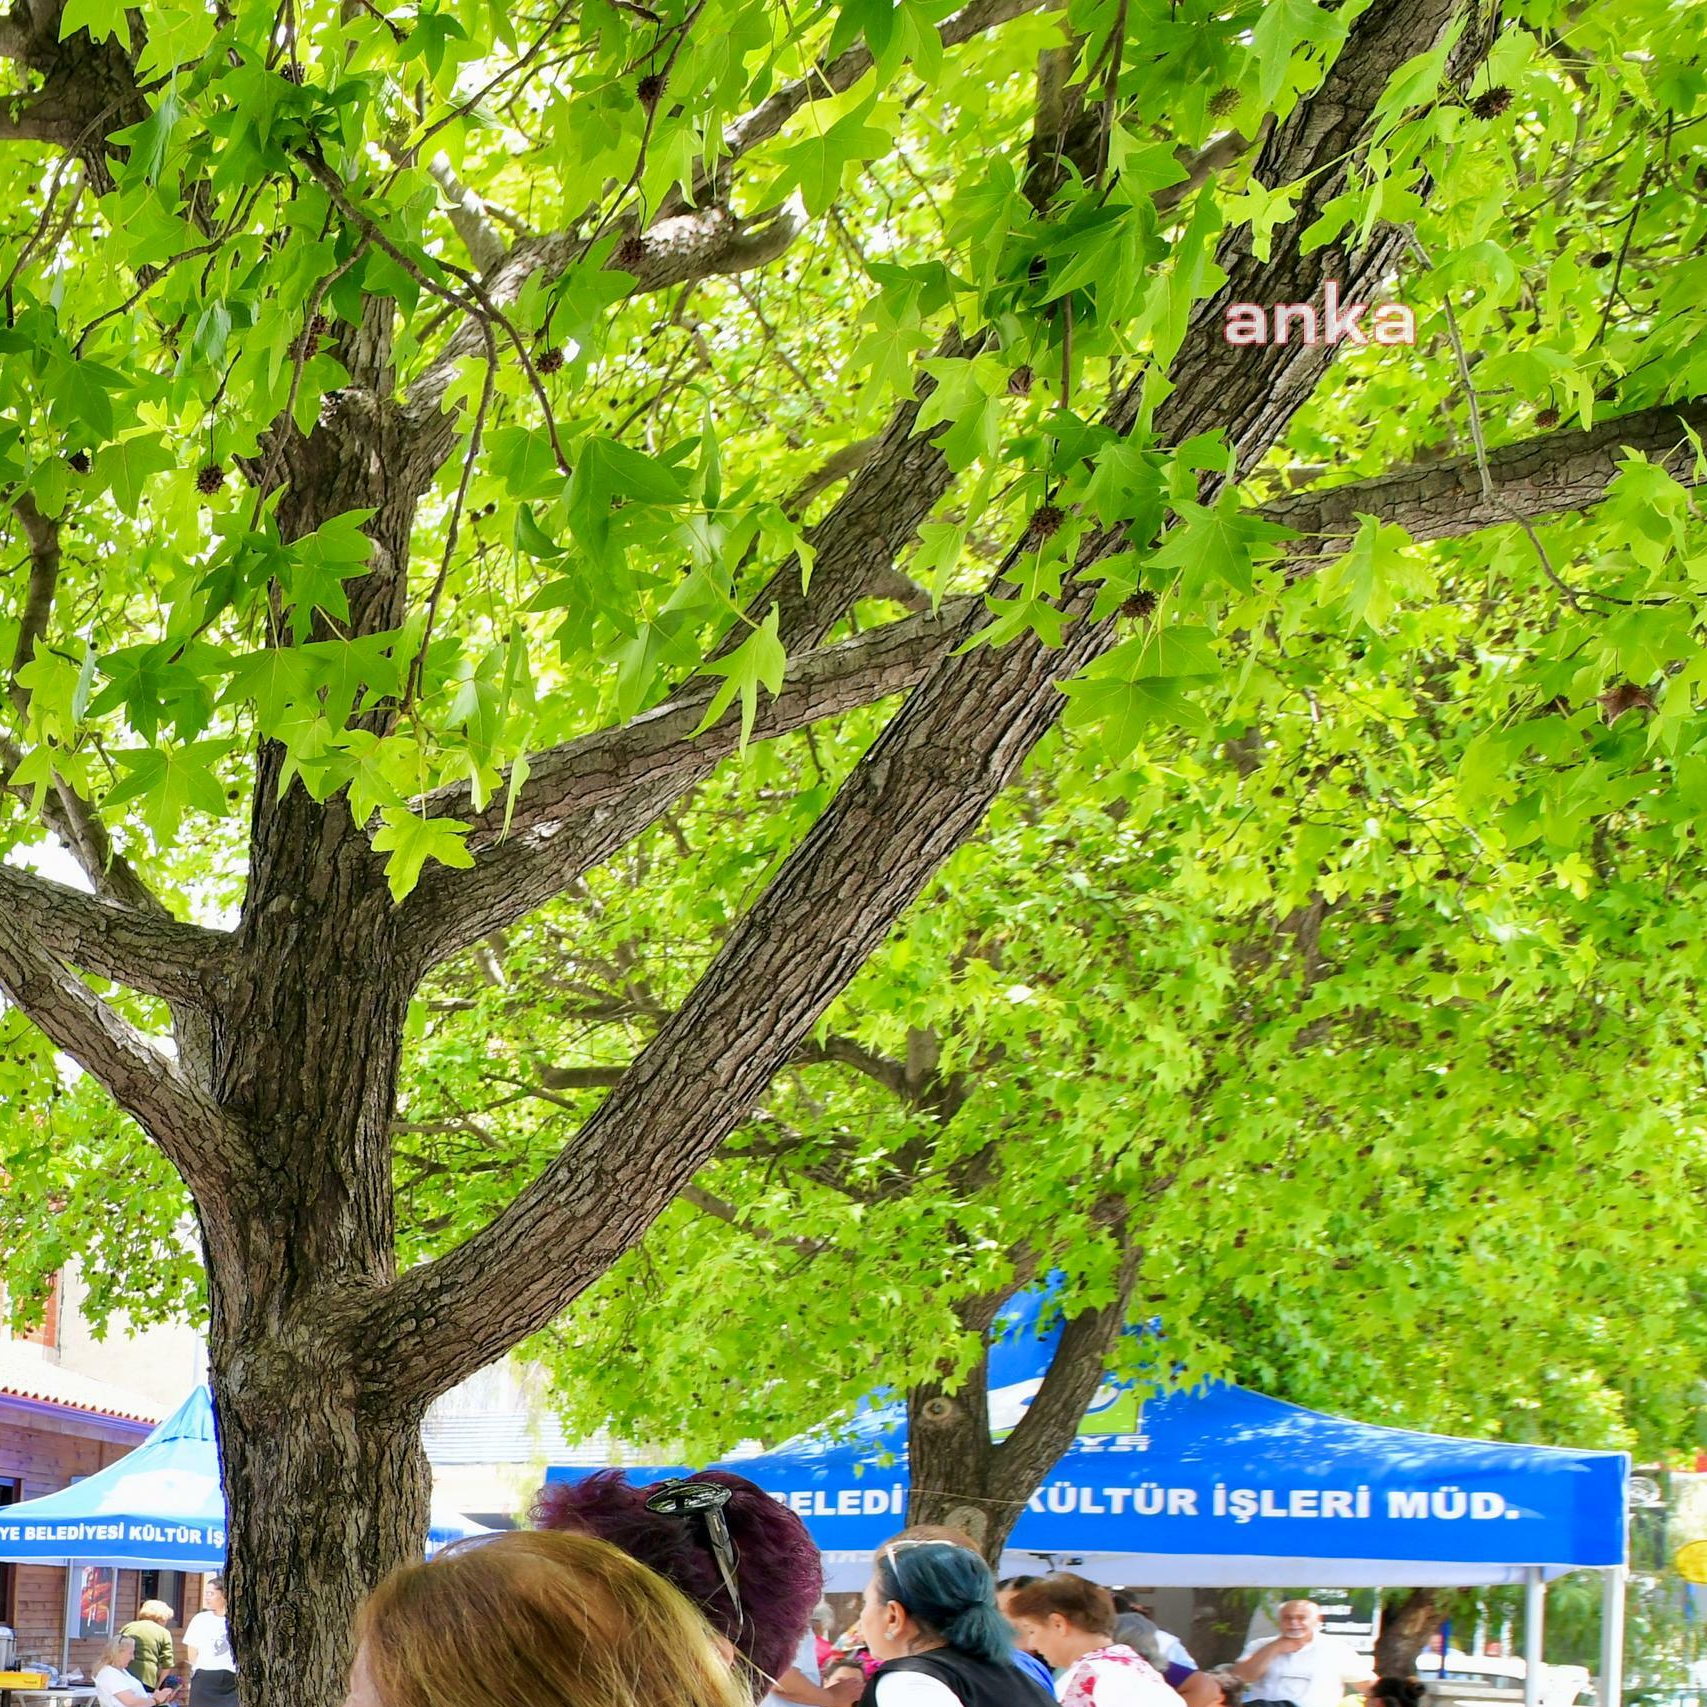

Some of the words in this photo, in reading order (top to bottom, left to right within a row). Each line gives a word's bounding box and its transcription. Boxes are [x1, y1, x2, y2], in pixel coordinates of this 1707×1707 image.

[1213, 1481, 1370, 1523] İŞLERİ
[1388, 1486, 1520, 1521] MÜD.
[24, 1521, 124, 1540] BELEDİYESİ
[129, 1524, 202, 1544] KÜLTÜR
